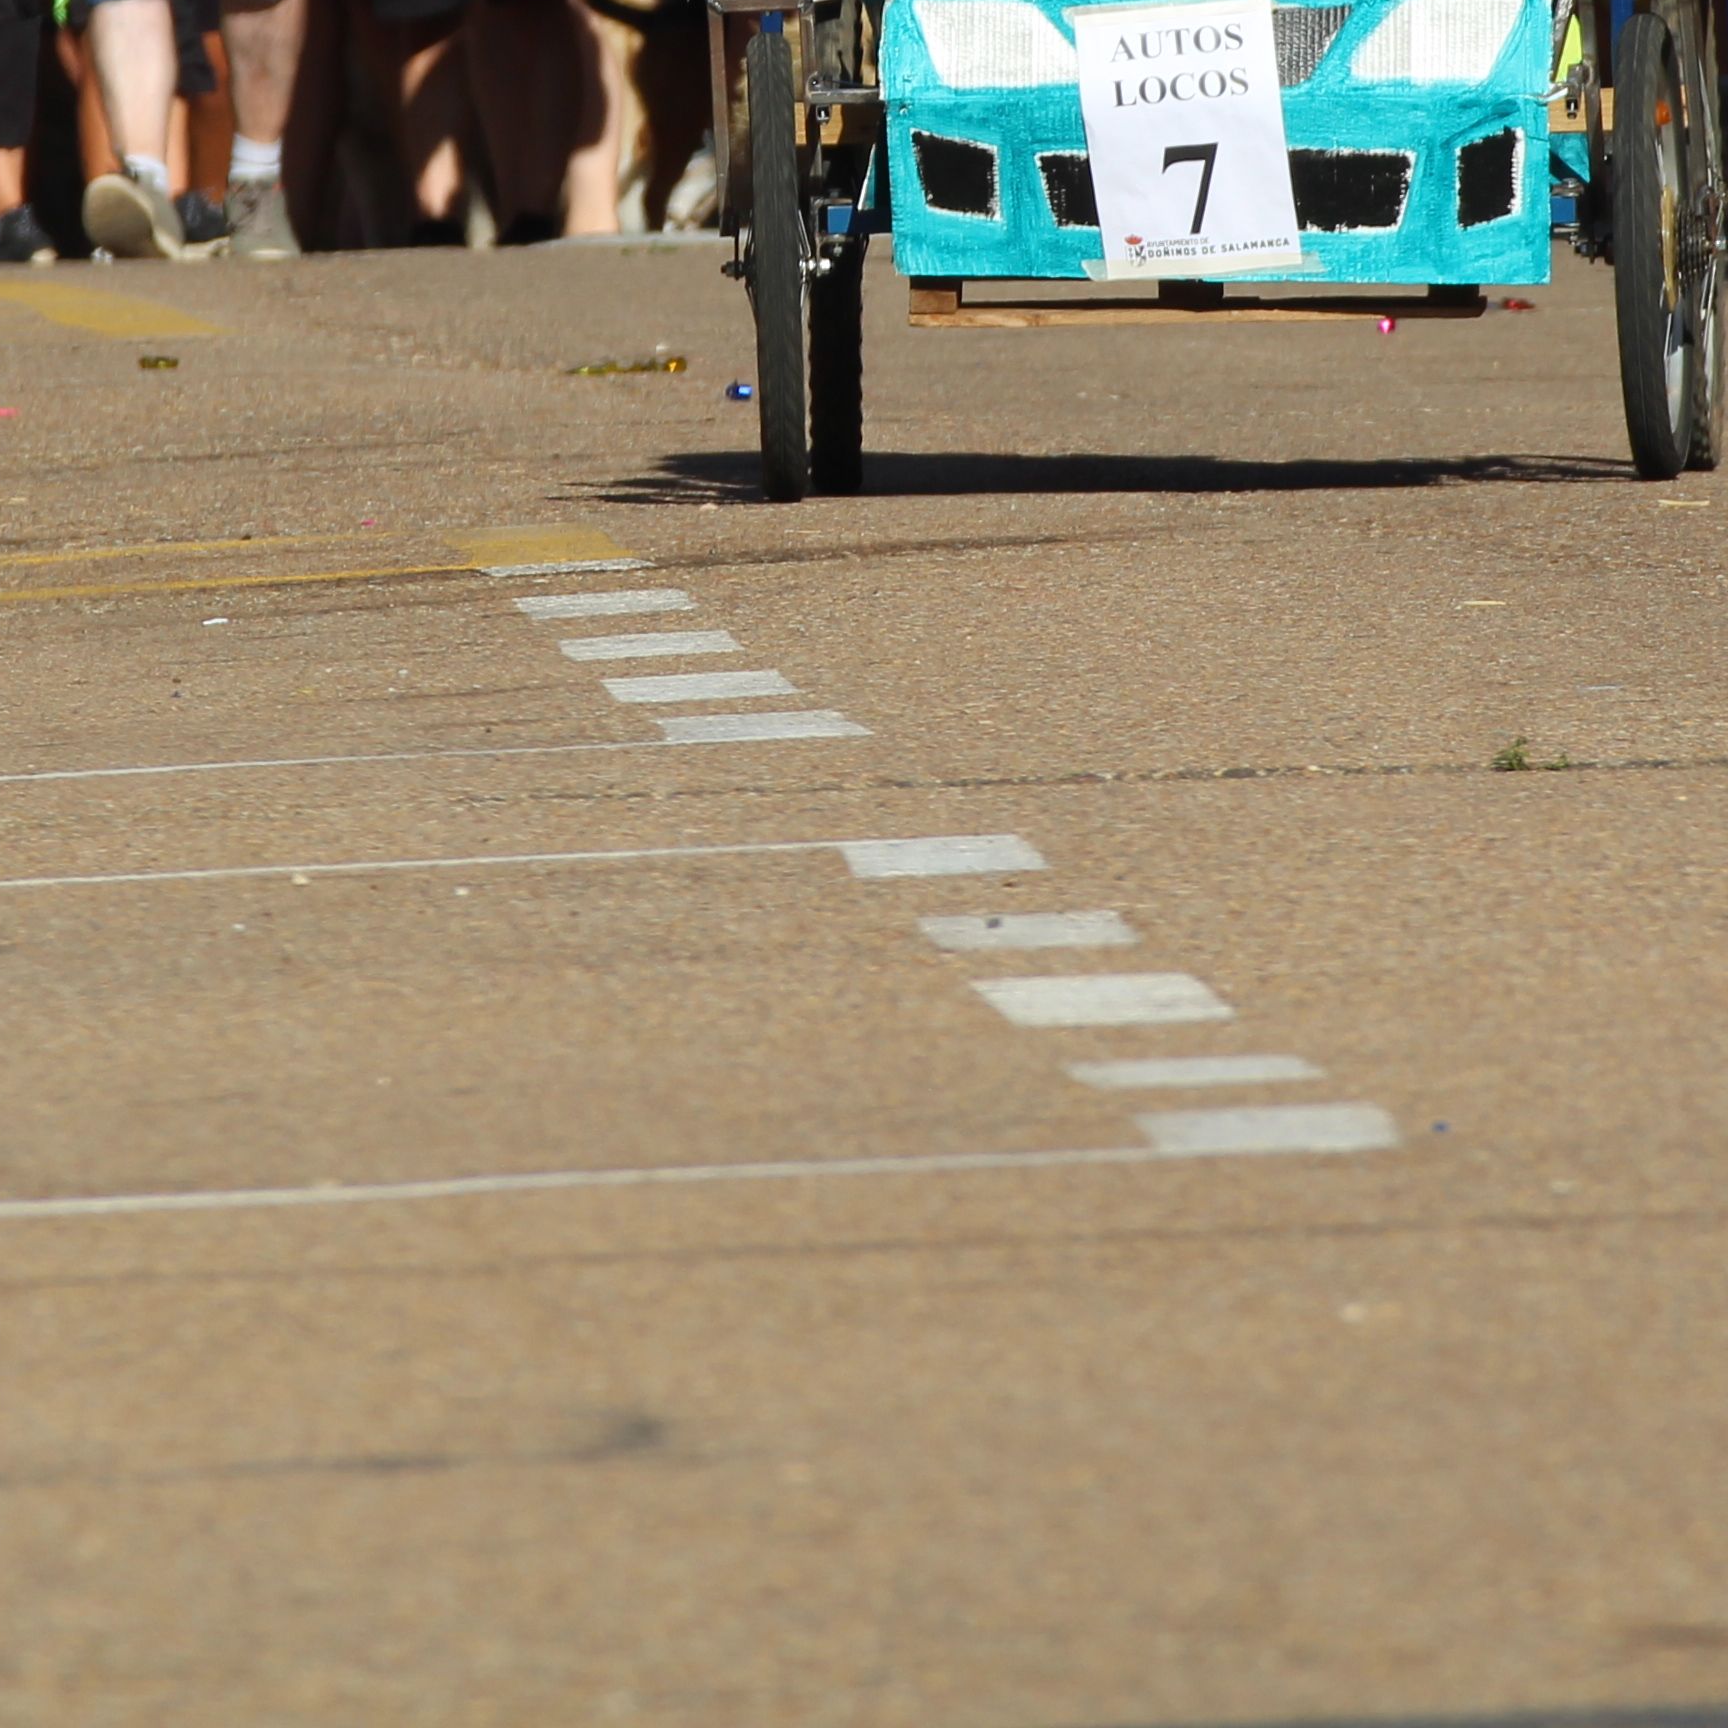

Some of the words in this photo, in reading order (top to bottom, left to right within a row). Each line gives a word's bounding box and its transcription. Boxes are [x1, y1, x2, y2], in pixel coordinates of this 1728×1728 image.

[1110, 22, 1244, 63] AUTOS
[1113, 67, 1249, 108] LOCOS
[1161, 141, 1219, 235] 7
[1146, 238, 1198, 248] AYUNTAMIENTO
[1200, 236, 1209, 245] DE
[1147, 245, 1197, 259] DOÑINOS
[1201, 246, 1216, 255] DE
[1221, 237, 1291, 254] SALAMANCA
